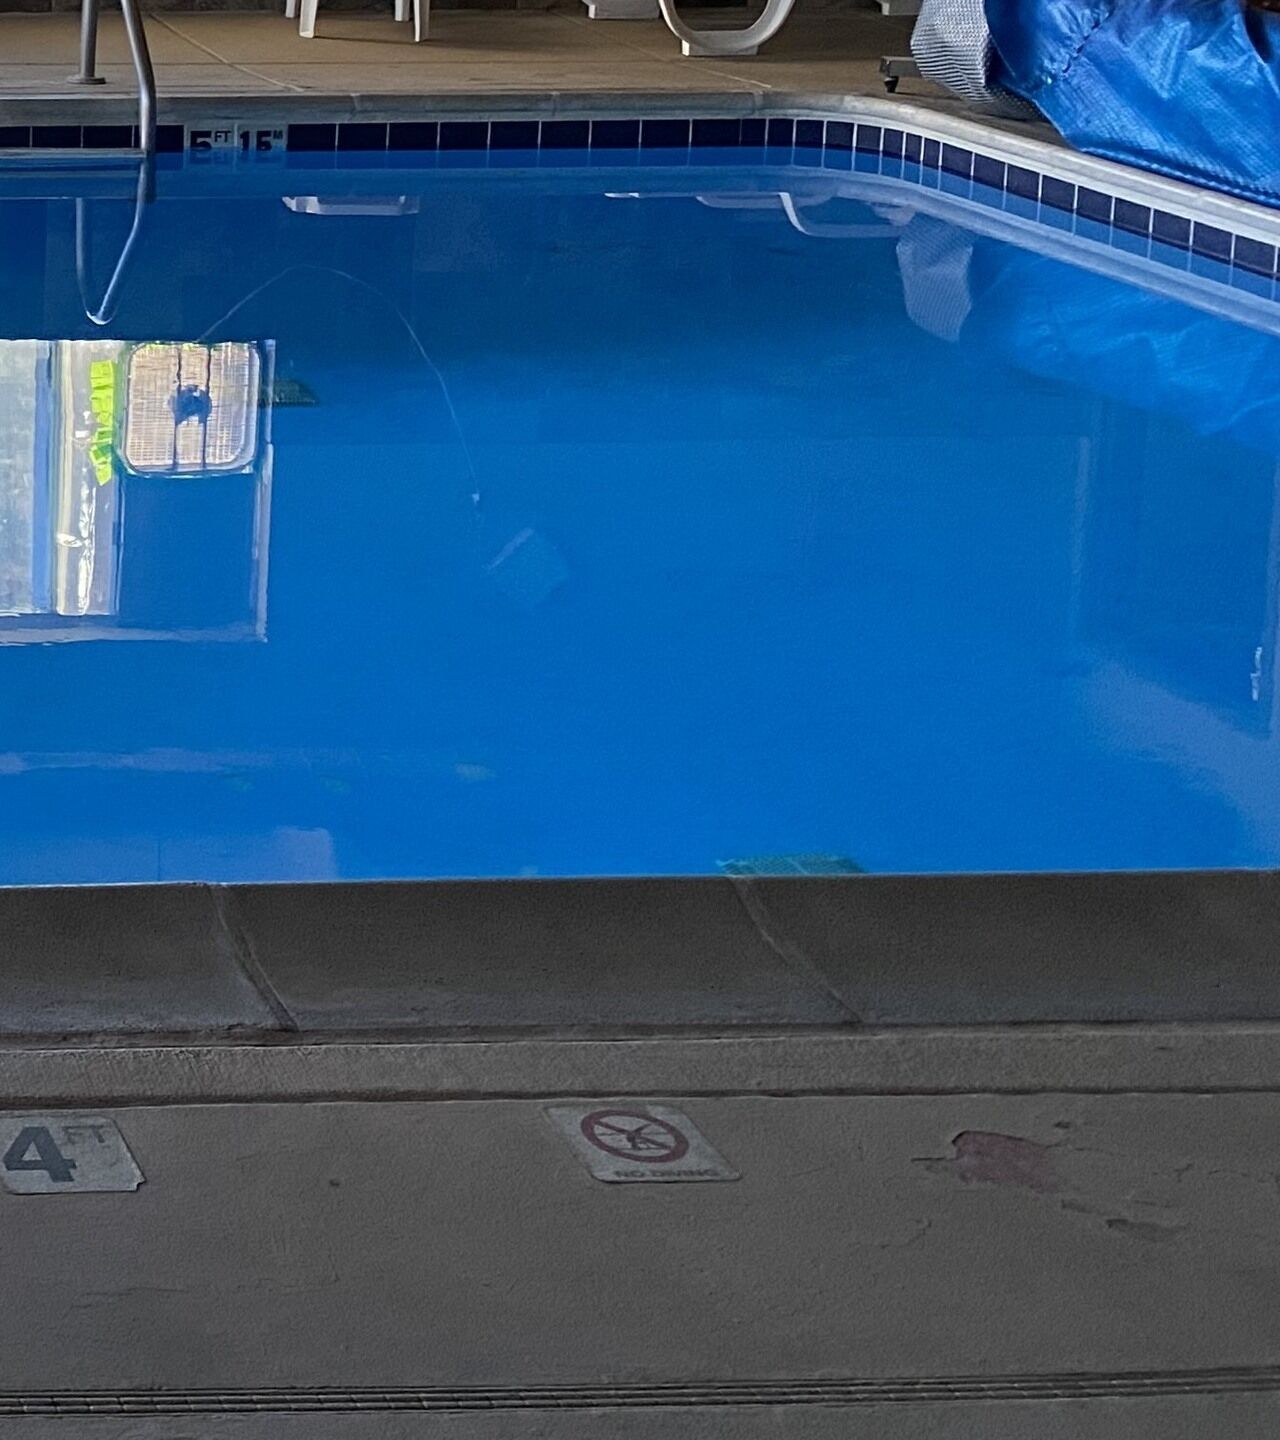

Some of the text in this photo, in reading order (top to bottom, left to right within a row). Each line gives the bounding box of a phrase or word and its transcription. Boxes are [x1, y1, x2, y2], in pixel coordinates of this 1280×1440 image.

[190, 130, 212, 149] 5
[214, 130, 231, 143] FT
[2, 1126, 77, 1182] 4
[613, 1169, 720, 1179] NO DIVING
